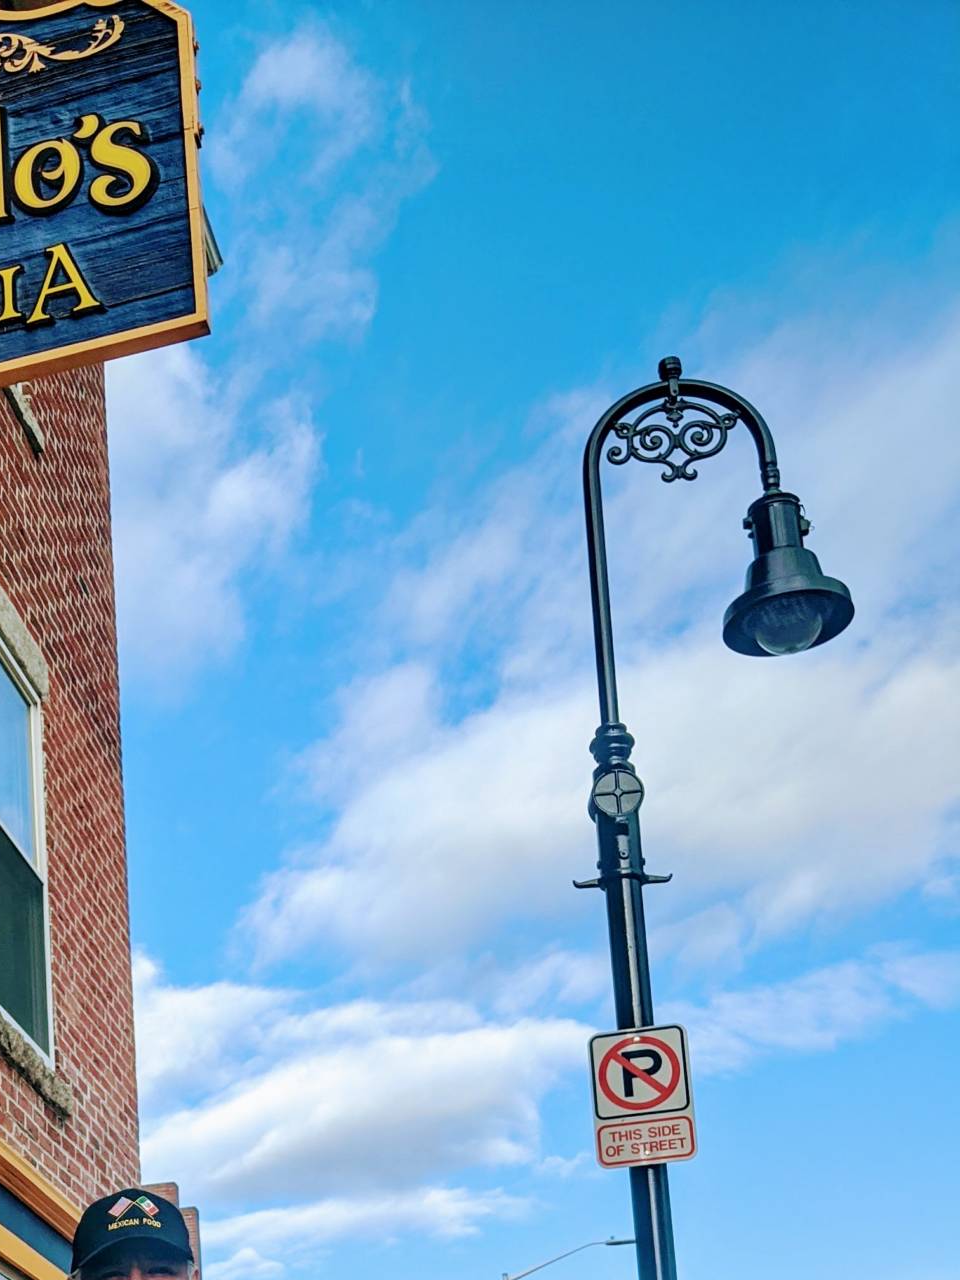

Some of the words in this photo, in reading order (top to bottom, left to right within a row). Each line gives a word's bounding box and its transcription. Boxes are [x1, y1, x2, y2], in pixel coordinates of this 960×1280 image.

[609, 1128, 642, 1143] THIS
[648, 1124, 681, 1138] SIDE
[606, 1144, 625, 1157] OF
[631, 1137, 687, 1155] STREET
[107, 1218, 140, 1231] MEXICAN
[142, 1217, 161, 1228] FOOD
